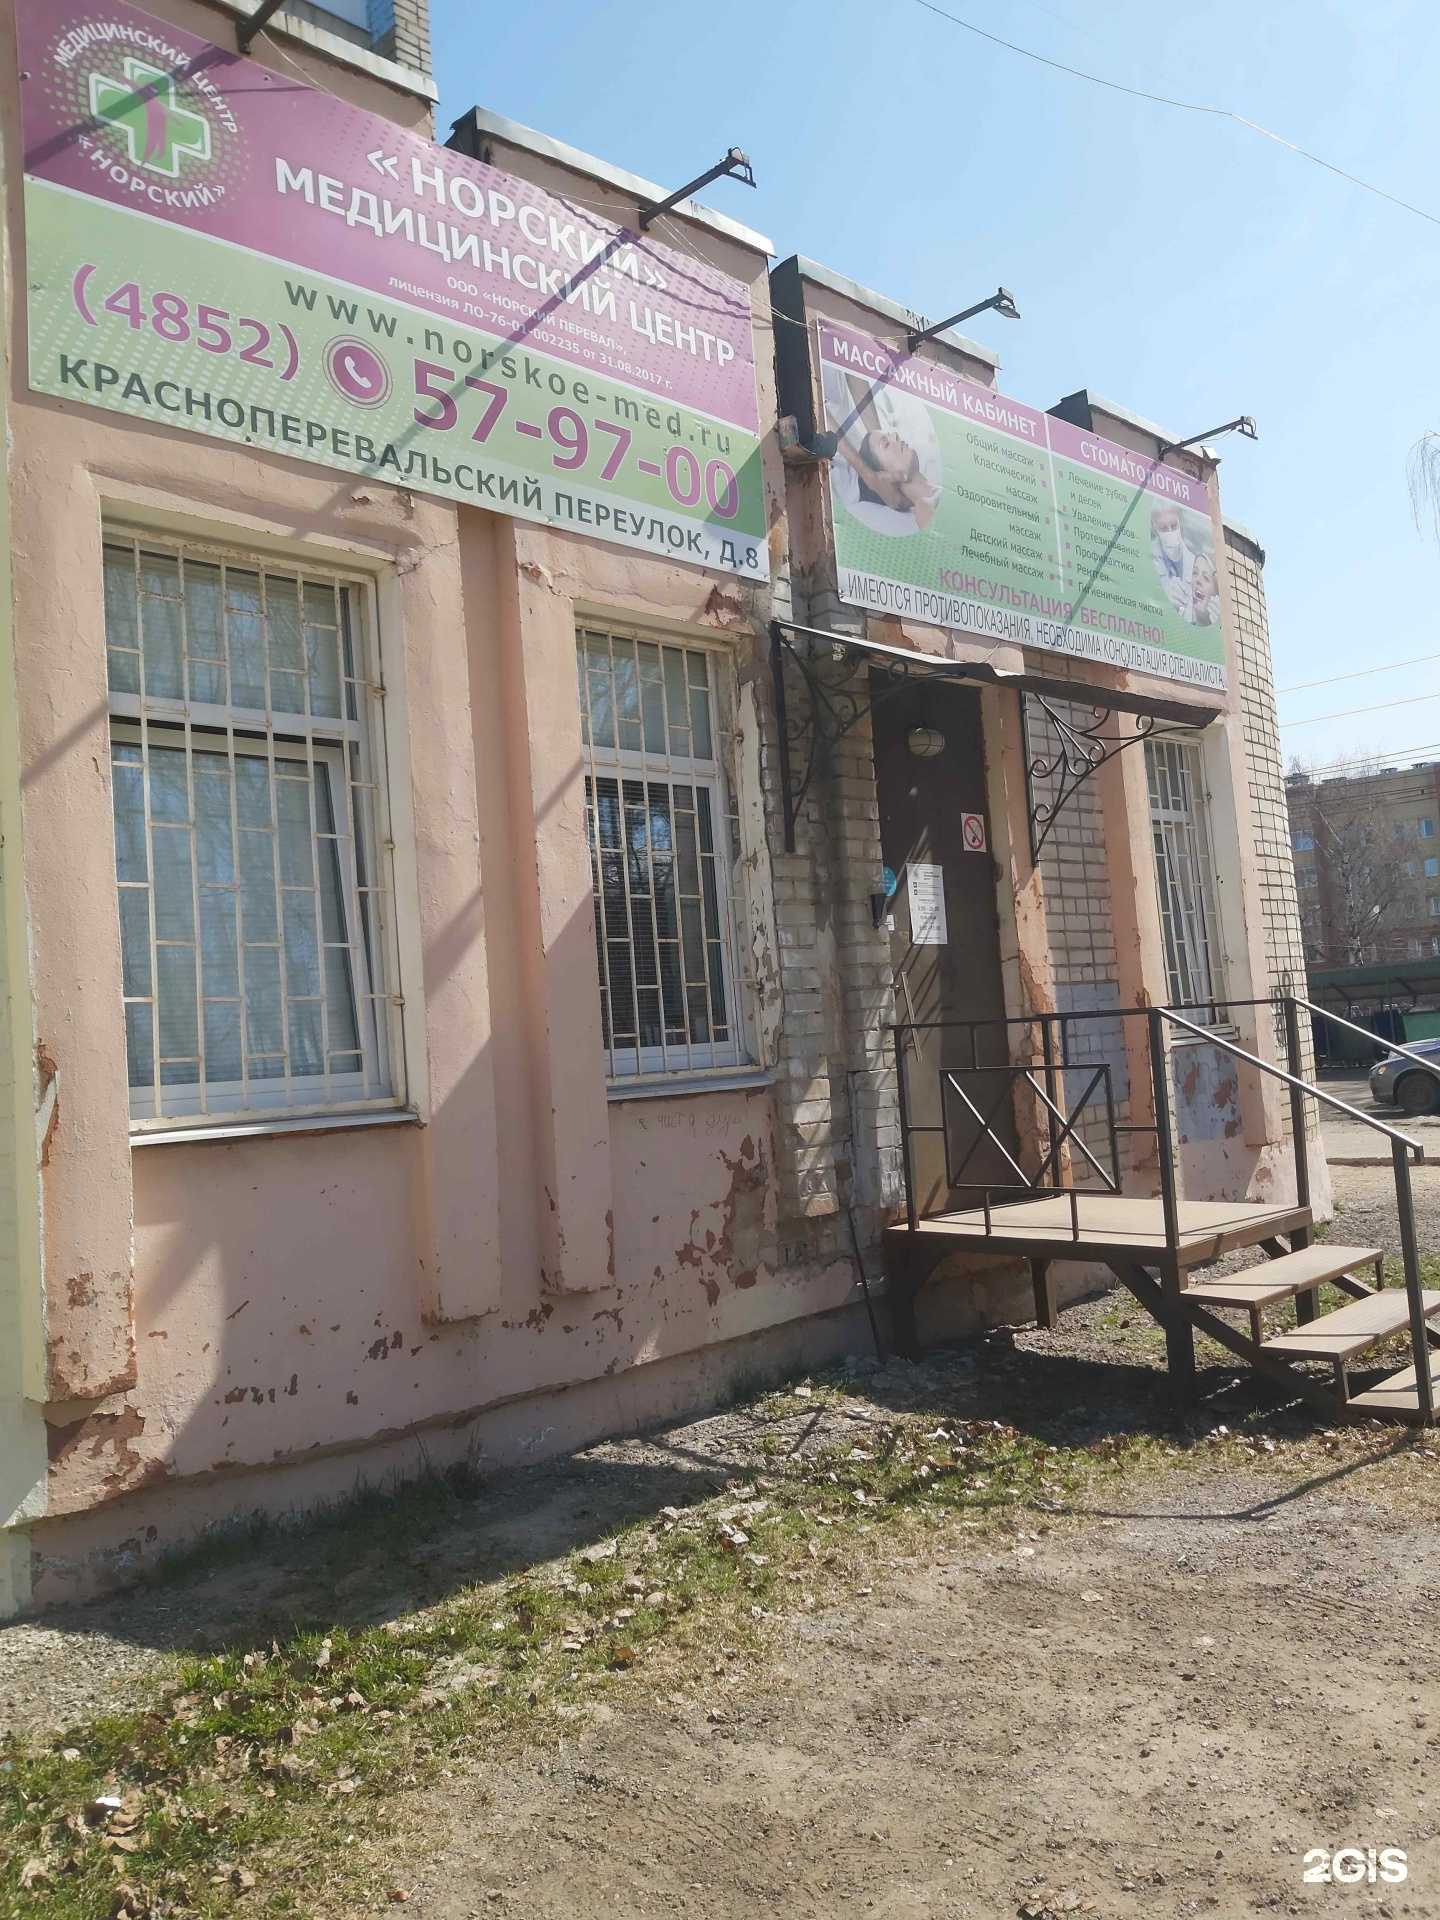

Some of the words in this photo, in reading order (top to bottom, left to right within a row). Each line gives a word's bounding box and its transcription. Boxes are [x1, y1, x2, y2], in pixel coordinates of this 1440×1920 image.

[52, 22, 192, 71] МЕДИЦИНСКИЙ
[191, 71, 238, 135] ЦЕНТР
[78, 133, 226, 208] «НОРСКИЙ»
[366, 150, 668, 292] «НОРСКИЙ»
[275, 157, 618, 323] МЕДИЦИНСКИЙ
[628, 300, 736, 367] ЦЕНТР
[447, 276, 479, 297] ООО
[482, 290, 556, 328] «НОРСКИЙ
[73, 263, 300, 381] (4852)
[388, 276, 460, 310] лицензия
[463, 301, 580, 355] ЛО-76-01-002235
[583, 347, 597, 361] от
[598, 351, 664, 386] 31.08.2017
[284, 280, 731, 453] www.norskoe-med.ru
[832, 337, 958, 406] МАССАЖНЫЙ
[962, 392, 1037, 437] КАБИНЕТ
[59, 354, 545, 512] КРАСНОПЕРЕВАЛЬСКИЙ
[554, 490, 711, 560] ПЕРЕУЛОК,
[412, 357, 741, 521] 57-97-00
[966, 431, 999, 455] Общий
[1001, 447, 1035, 467] массаж
[973, 453, 1037, 487] Классический
[1080, 440, 1190, 500] СТОМАТОЛОГИЯ
[957, 484, 1041, 523] Оздоровительный
[1006, 485, 1039, 504] массаж
[1009, 523, 1042, 541] массаж
[961, 545, 1009, 569] Лечебный
[1011, 561, 1045, 579] массаж
[970, 527, 1008, 549] Детский
[1010, 542, 1044, 561] массаж
[847, 573, 912, 612] ИМЕЮТСЯ
[1036, 622, 1102, 657] НЕОБХОДИМА
[1103, 639, 1168, 673] КОНСУЛЬТАЦИЯ
[937, 567, 1074, 619] КОНСУЛЬТАЦИЯ
[1080, 606, 1168, 647] БЕСПЛАТНО!
